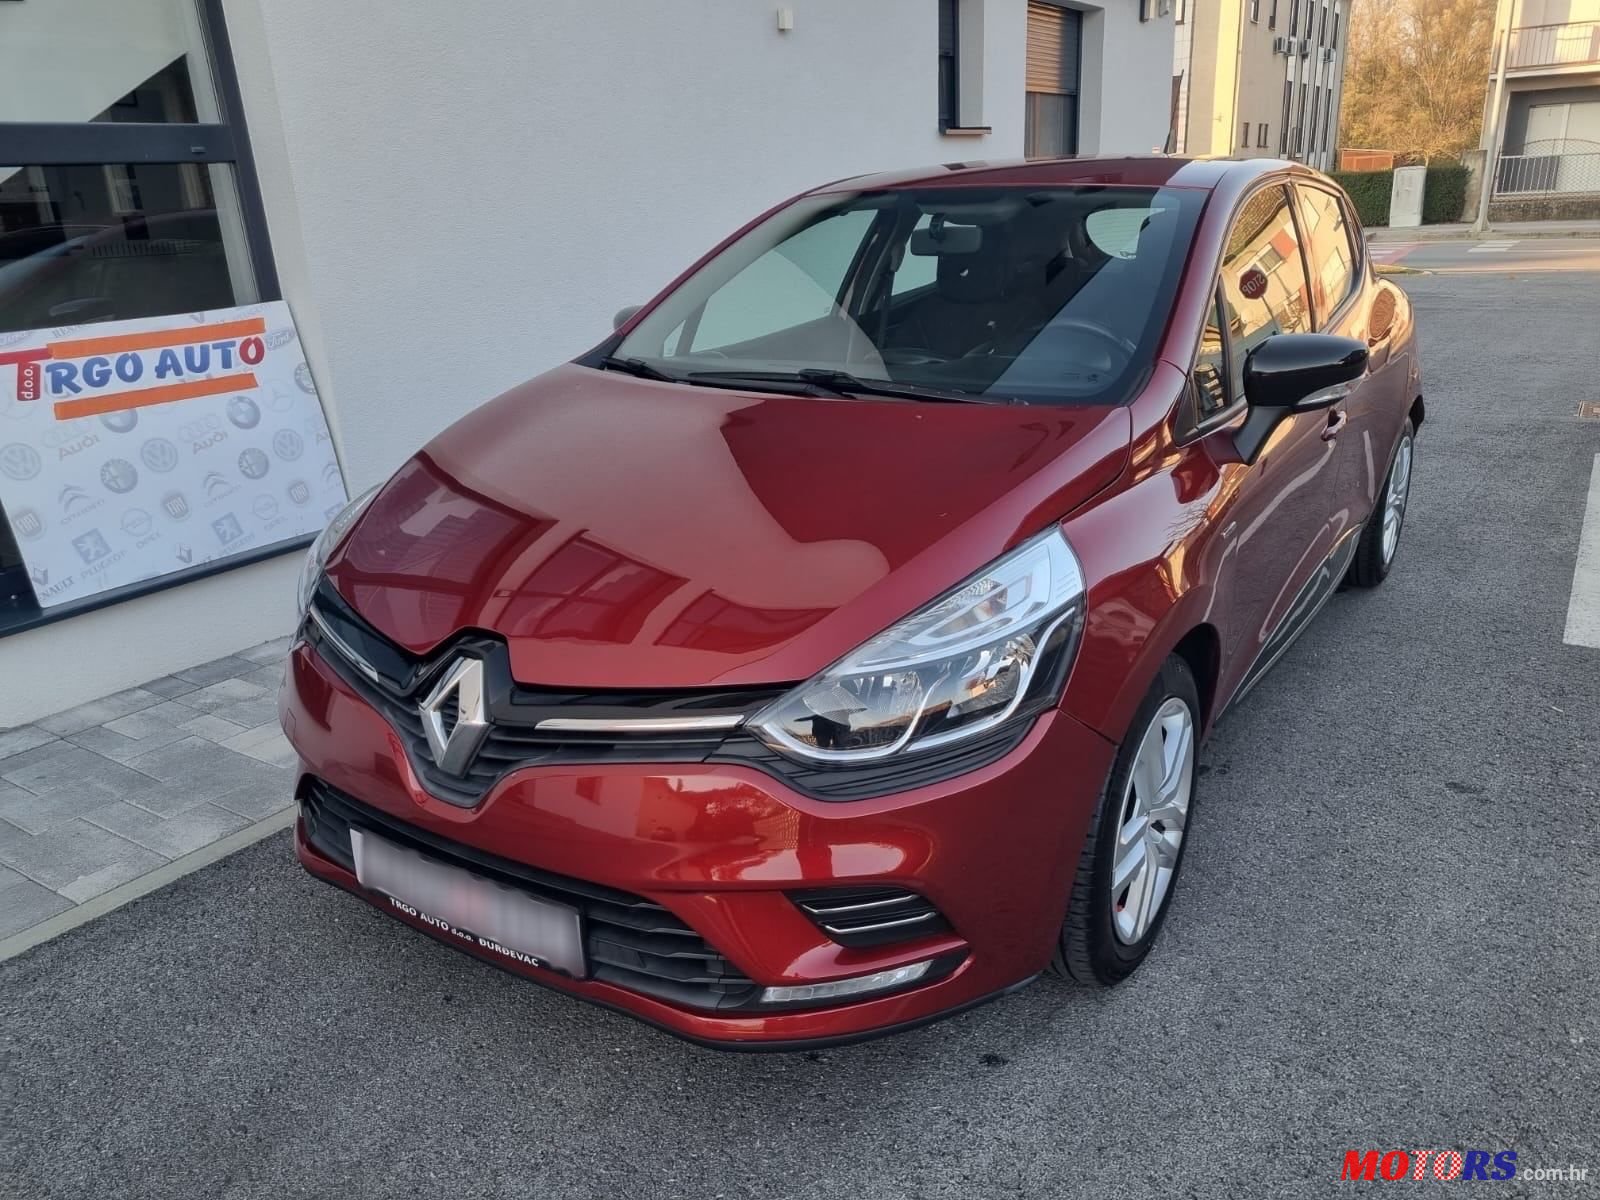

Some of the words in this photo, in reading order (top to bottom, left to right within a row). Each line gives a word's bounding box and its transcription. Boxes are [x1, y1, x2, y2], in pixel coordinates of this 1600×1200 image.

[154, 336, 266, 380] AUTO
[21, 365, 34, 399] d.o.o.
[389, 897, 417, 917] TRGO
[420, 912, 449, 931] AUTO
[451, 927, 474, 942] d.o.o.
